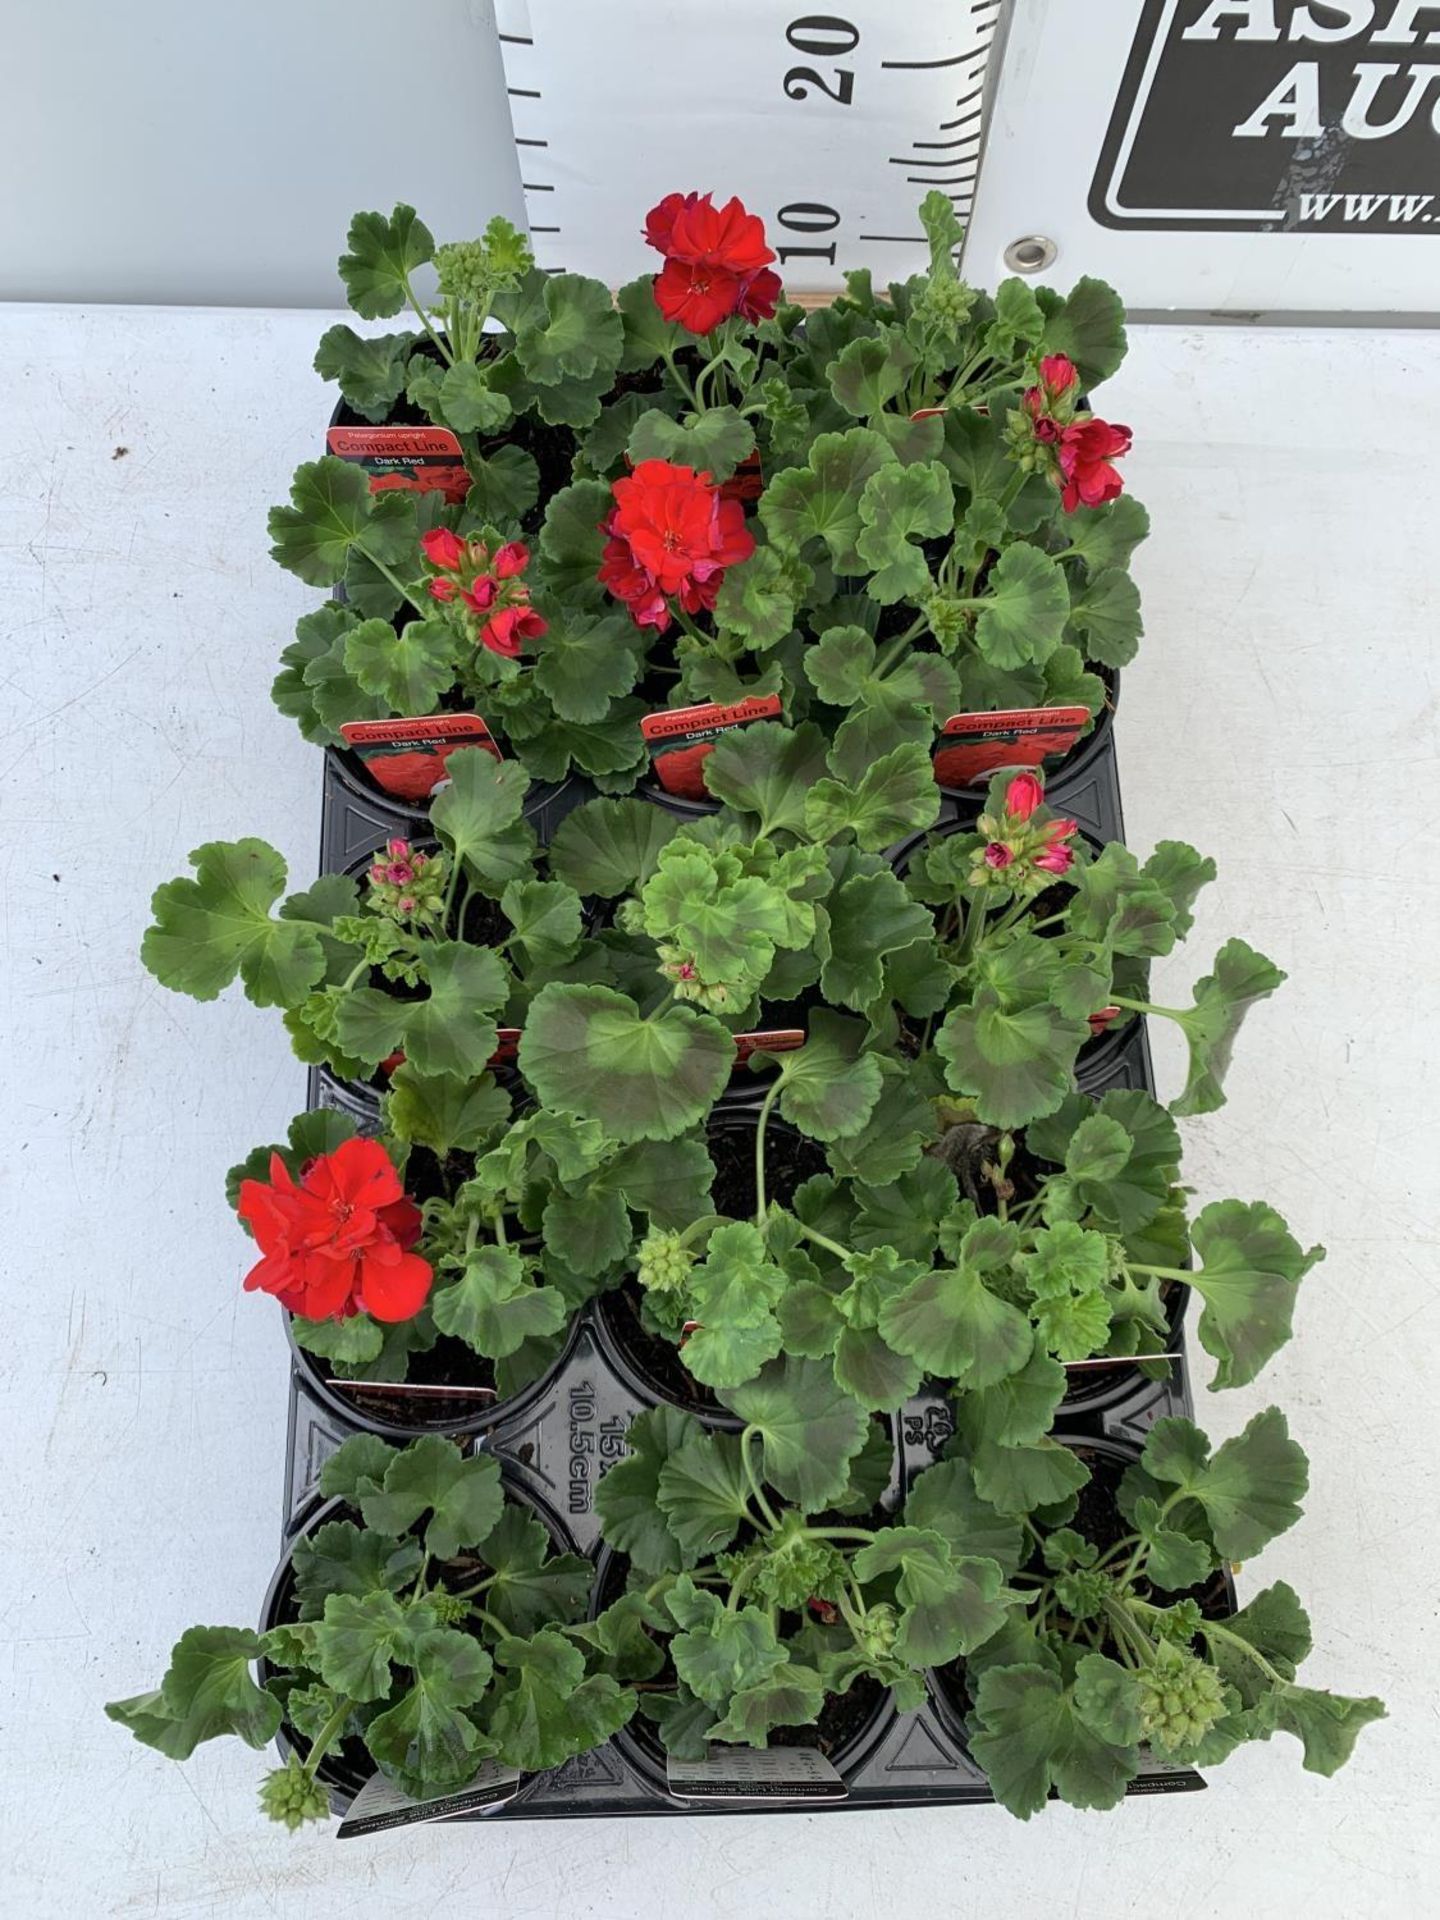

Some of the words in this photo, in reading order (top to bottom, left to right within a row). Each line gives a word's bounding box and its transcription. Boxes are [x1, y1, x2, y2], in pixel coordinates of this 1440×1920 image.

[783, 15, 859, 105] 20
[1232, 61, 1440, 139] AU
[1299, 193, 1440, 222] www.
[776, 202, 841, 265] 10
[337, 440, 411, 453] Compact
[414, 440, 449, 451] Line
[374, 457, 401, 465] Dark
[402, 457, 425, 465] Red
[649, 713, 727, 734] Compact
[732, 705, 768, 718] Line
[952, 719, 1034, 732] Compact
[1038, 715, 1076, 725] Line
[351, 729, 432, 742] Compact
[438, 723, 473, 734] Line
[391, 740, 420, 748] Dark
[422, 737, 447, 745] Red
[685, 729, 714, 740] Dark
[715, 724, 738, 735] Red
[983, 730, 1010, 738] Dark
[1012, 727, 1038, 736] Red
[904, 1416, 923, 1445] PS
[569, 1381, 596, 1514] 10.5cm
